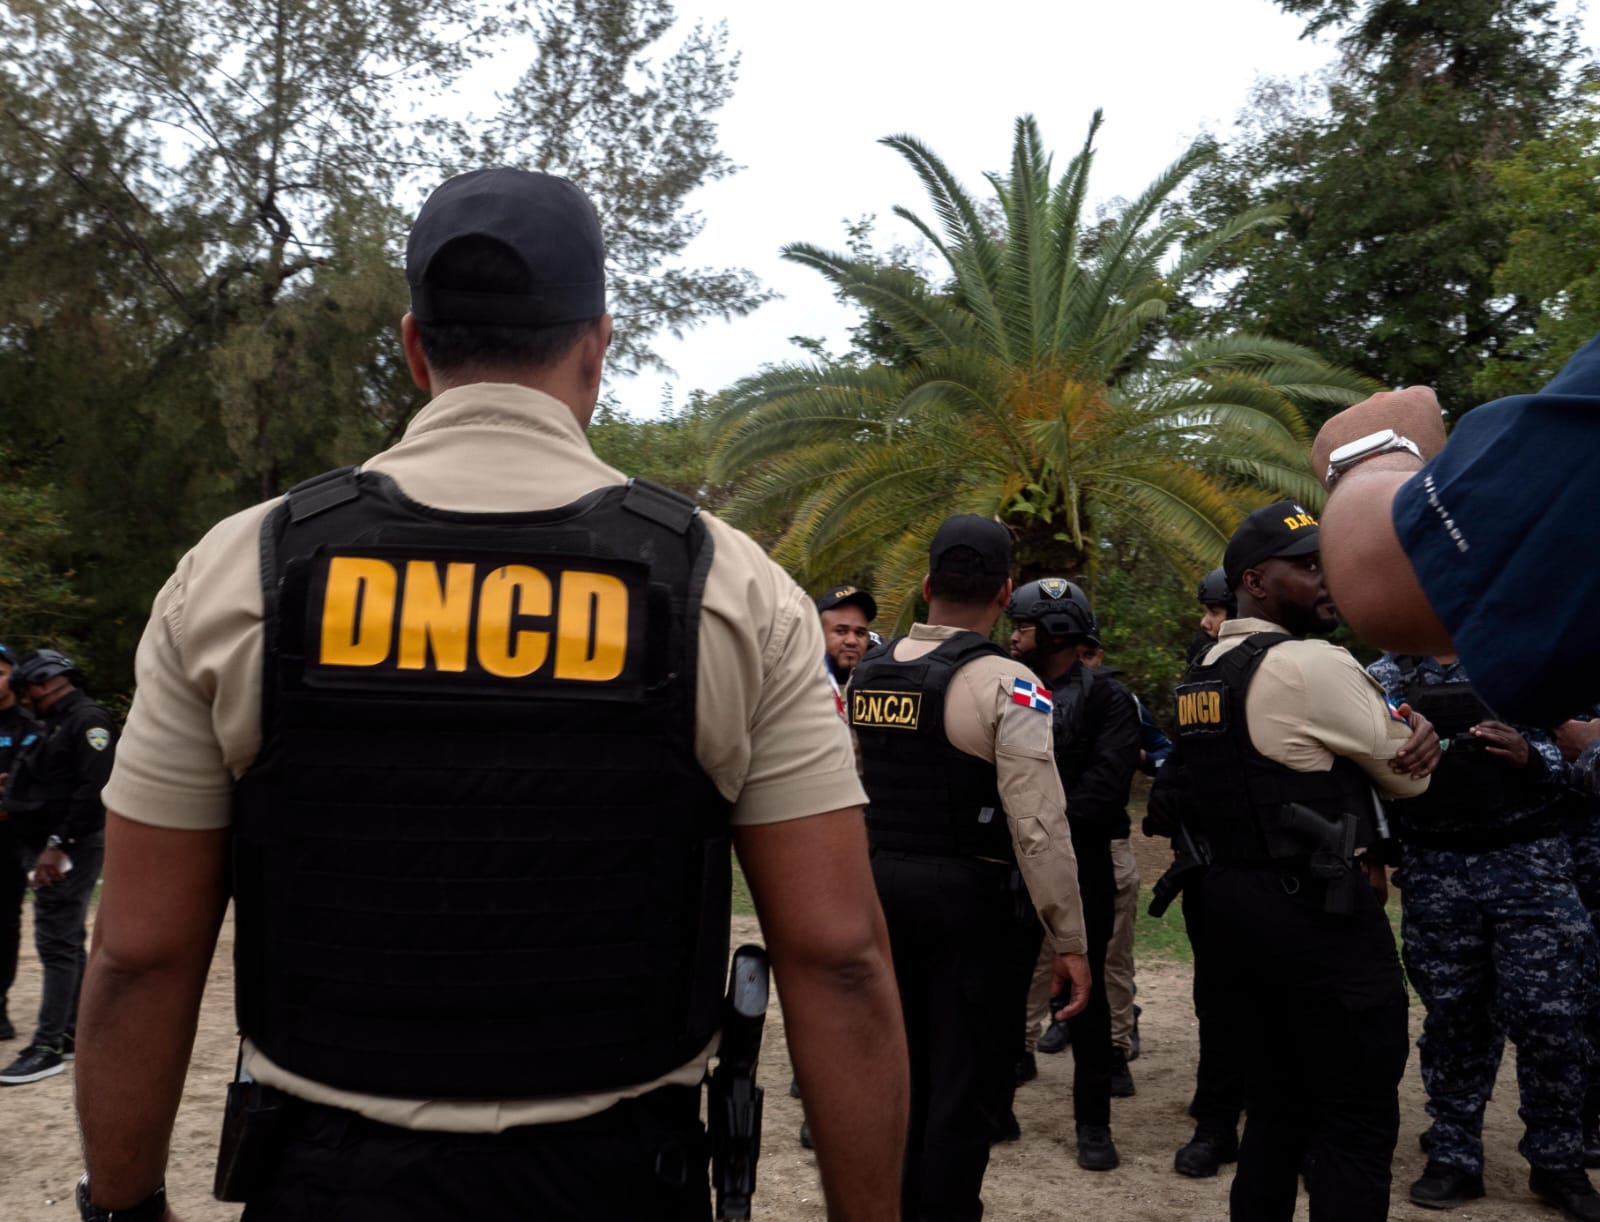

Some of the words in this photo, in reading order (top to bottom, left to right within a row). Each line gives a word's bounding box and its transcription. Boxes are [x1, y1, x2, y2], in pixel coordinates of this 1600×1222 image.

[319, 556, 629, 682] DNCD
[855, 695, 916, 725] D.N.C.D.
[1178, 690, 1221, 726] DNCD
